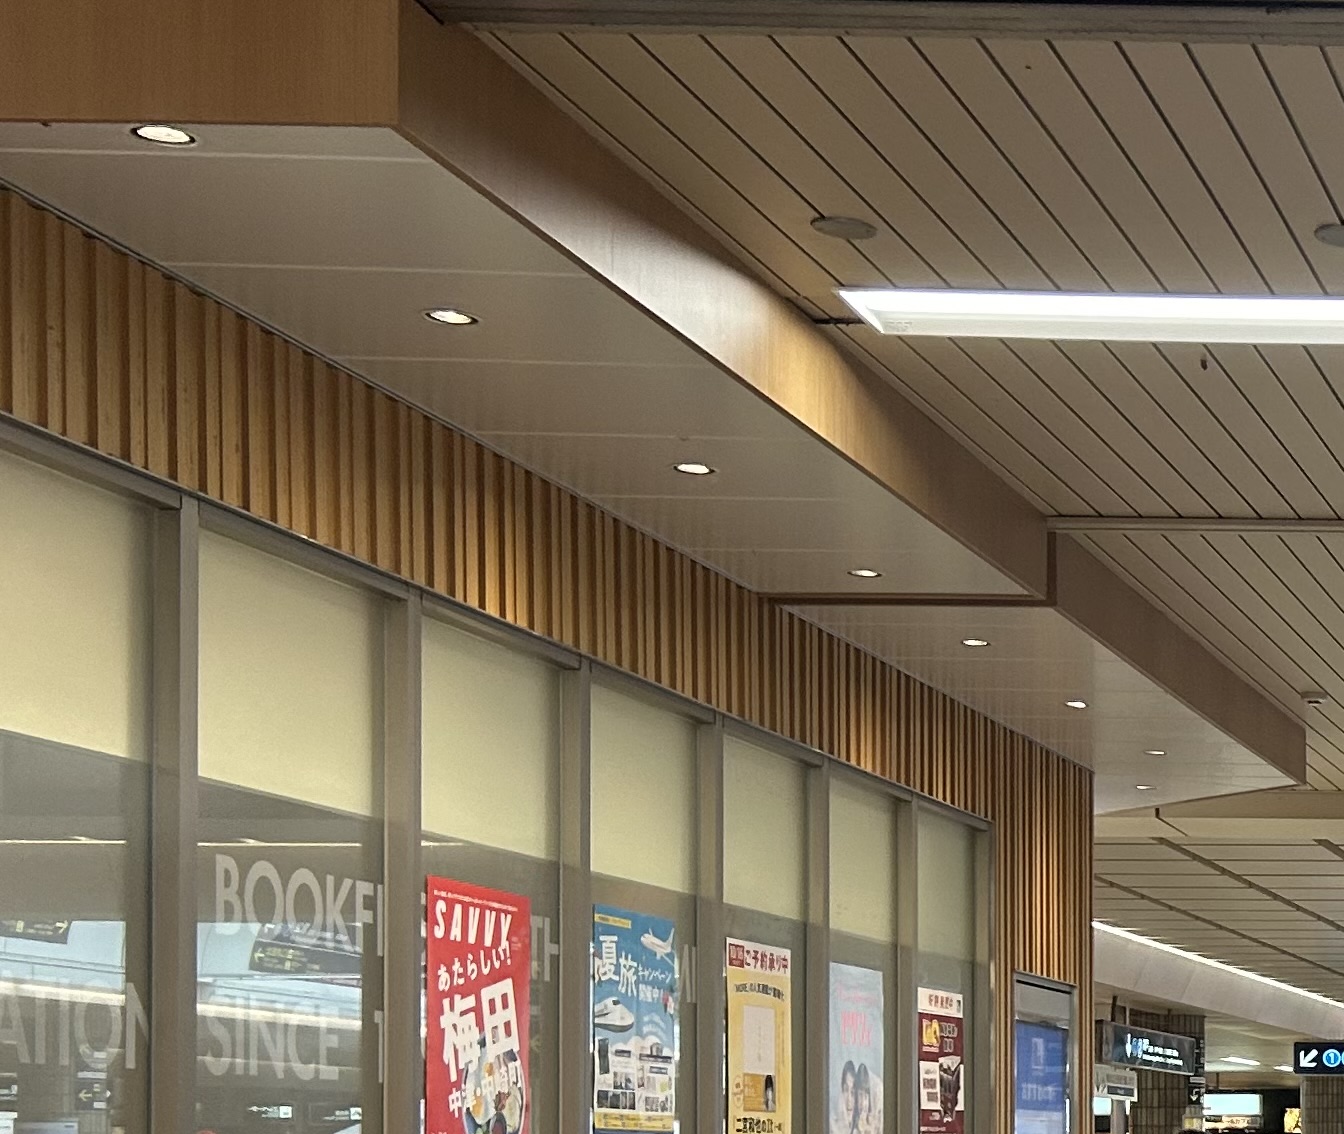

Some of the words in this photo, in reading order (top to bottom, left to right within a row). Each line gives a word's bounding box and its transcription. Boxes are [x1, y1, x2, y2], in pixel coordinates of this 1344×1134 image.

[215, 853, 383, 957] BOOKFI
[434, 899, 512, 949] SAVVY
[204, 995, 339, 1081] SINCE
[440, 978, 519, 1082] 梅田
